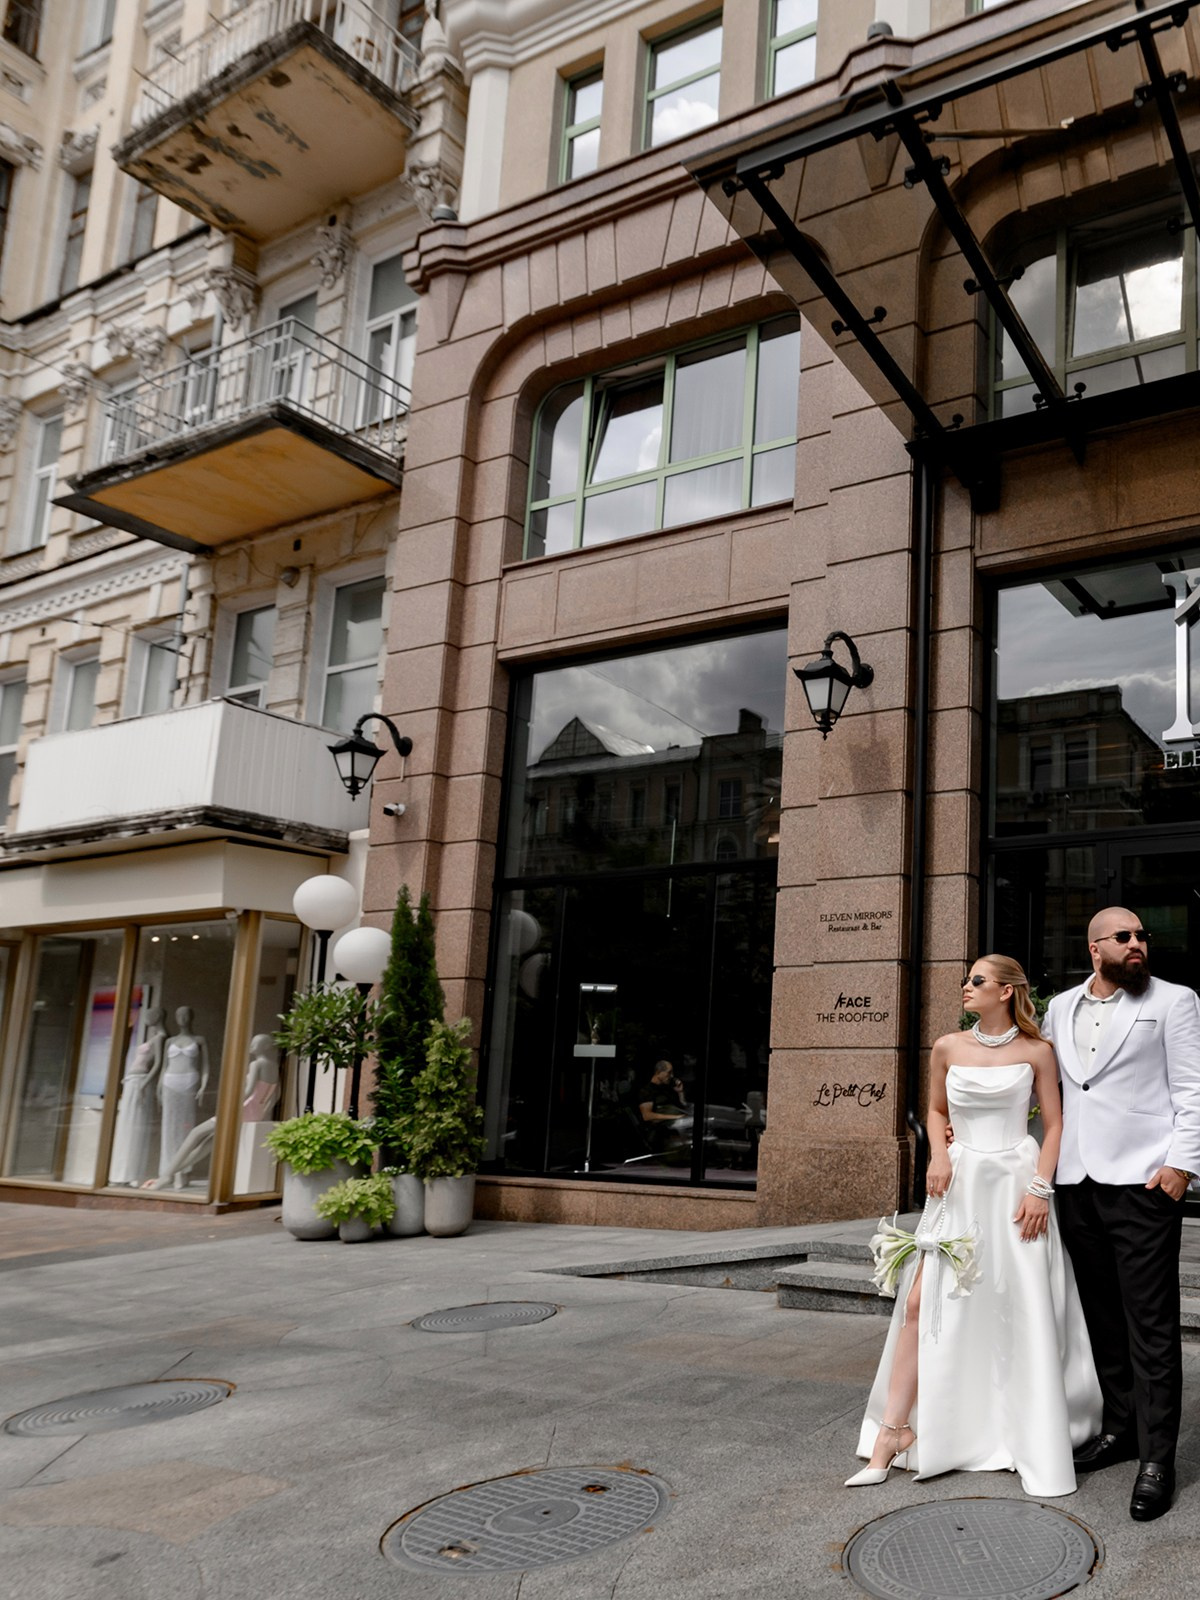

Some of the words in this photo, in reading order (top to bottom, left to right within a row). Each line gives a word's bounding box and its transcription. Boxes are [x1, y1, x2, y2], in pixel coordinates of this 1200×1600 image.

[820, 913, 852, 922] ELEVEN
[854, 910, 892, 920] MIRRORS
[828, 924, 860, 932] Restaurant
[862, 923, 869, 931] &
[871, 922, 882, 930] Bar
[816, 1013, 835, 1023] THE
[838, 1012, 889, 1022] ROOFTOP
[813, 1083, 830, 1107] Le
[858, 1082, 887, 1107] Chef
